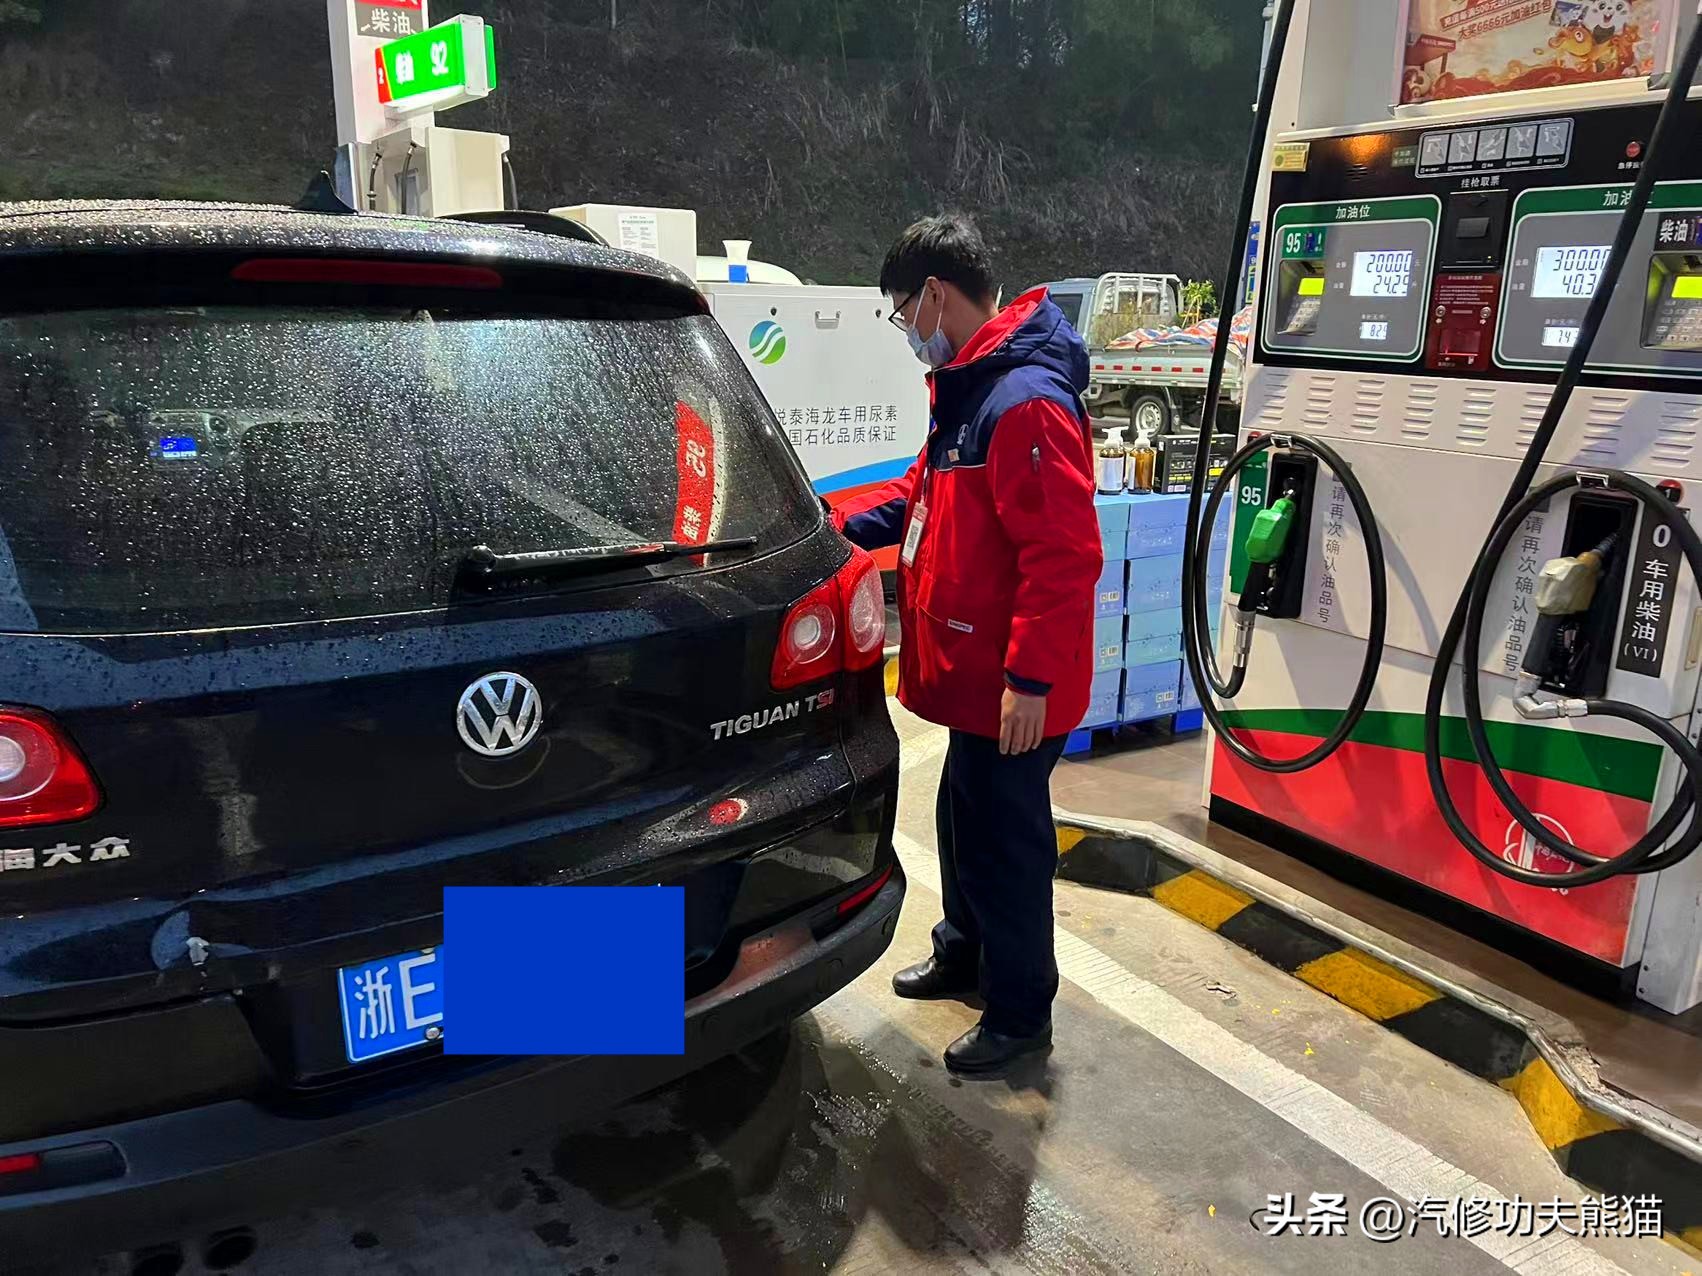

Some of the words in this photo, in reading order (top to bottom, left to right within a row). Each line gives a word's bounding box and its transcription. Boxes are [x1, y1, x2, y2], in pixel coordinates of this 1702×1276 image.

[371, 8, 411, 35] 柴油
[429, 40, 449, 76] 92
[1335, 205, 1371, 219] 加油位
[1603, 189, 1655, 206] 加油
[1285, 232, 1301, 253] 95
[1659, 219, 1689, 243] 柴油
[1241, 486, 1262, 506] 95
[1317, 486, 1346, 623] 请再次确认油品号
[1502, 515, 1544, 671] 请再次确认油品号
[1631, 559, 1669, 642] 车用柴油
[710, 701, 800, 741] TIGUAN
[805, 688, 835, 712] TSI
[354, 952, 444, 1039] 浙E
